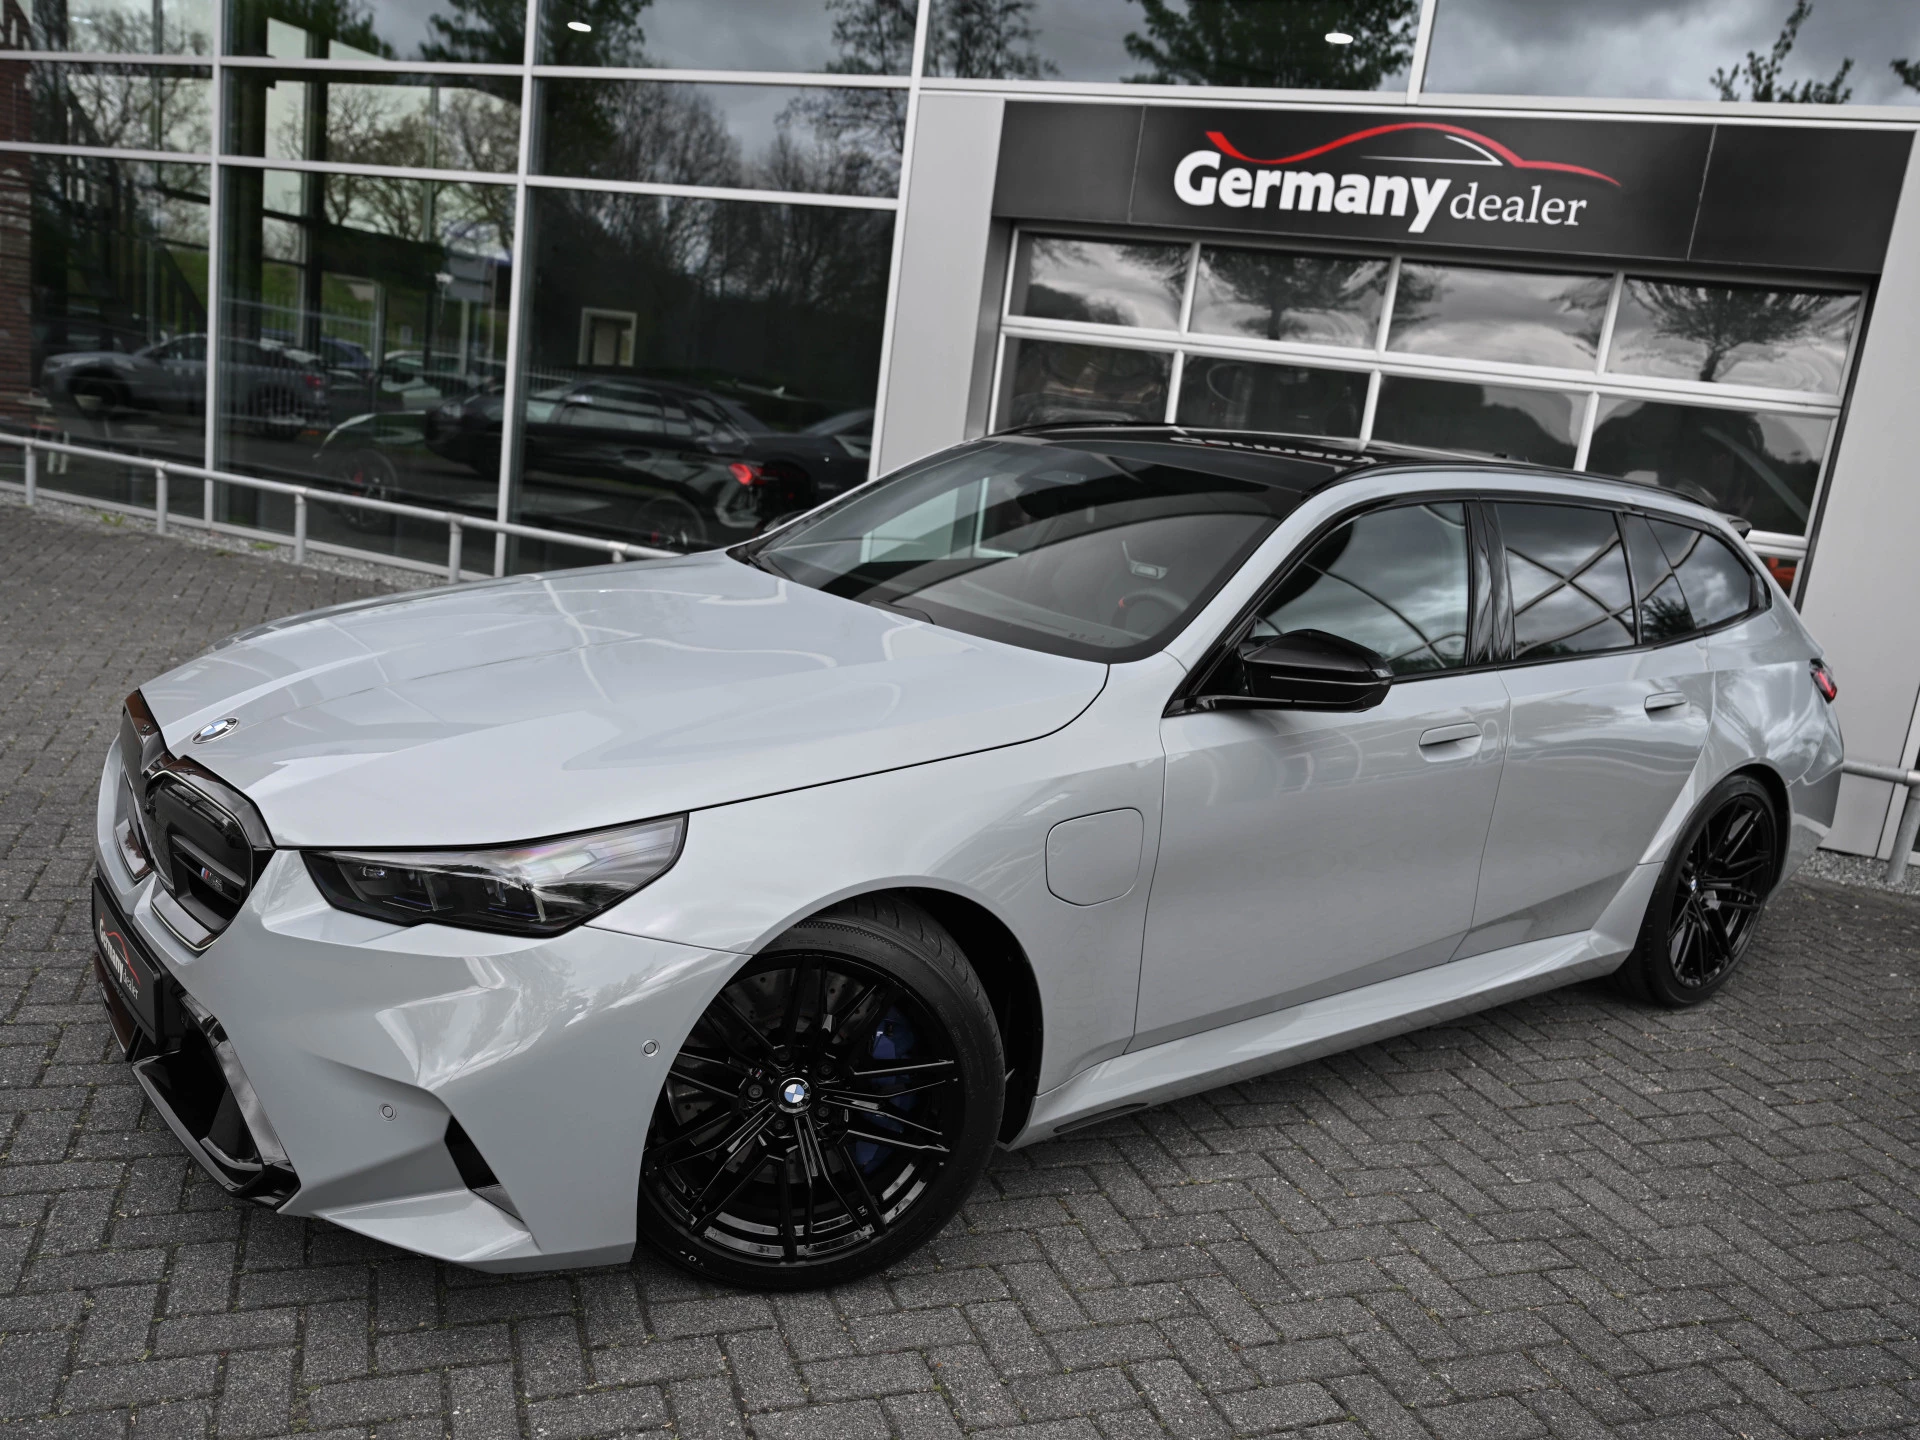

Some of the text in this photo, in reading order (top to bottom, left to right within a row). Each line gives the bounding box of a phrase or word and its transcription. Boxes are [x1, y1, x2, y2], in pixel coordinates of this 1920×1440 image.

[1174, 150, 1587, 233] Germany dealer
[100, 917, 125, 983] Germany
[121, 969, 138, 999] dealer
